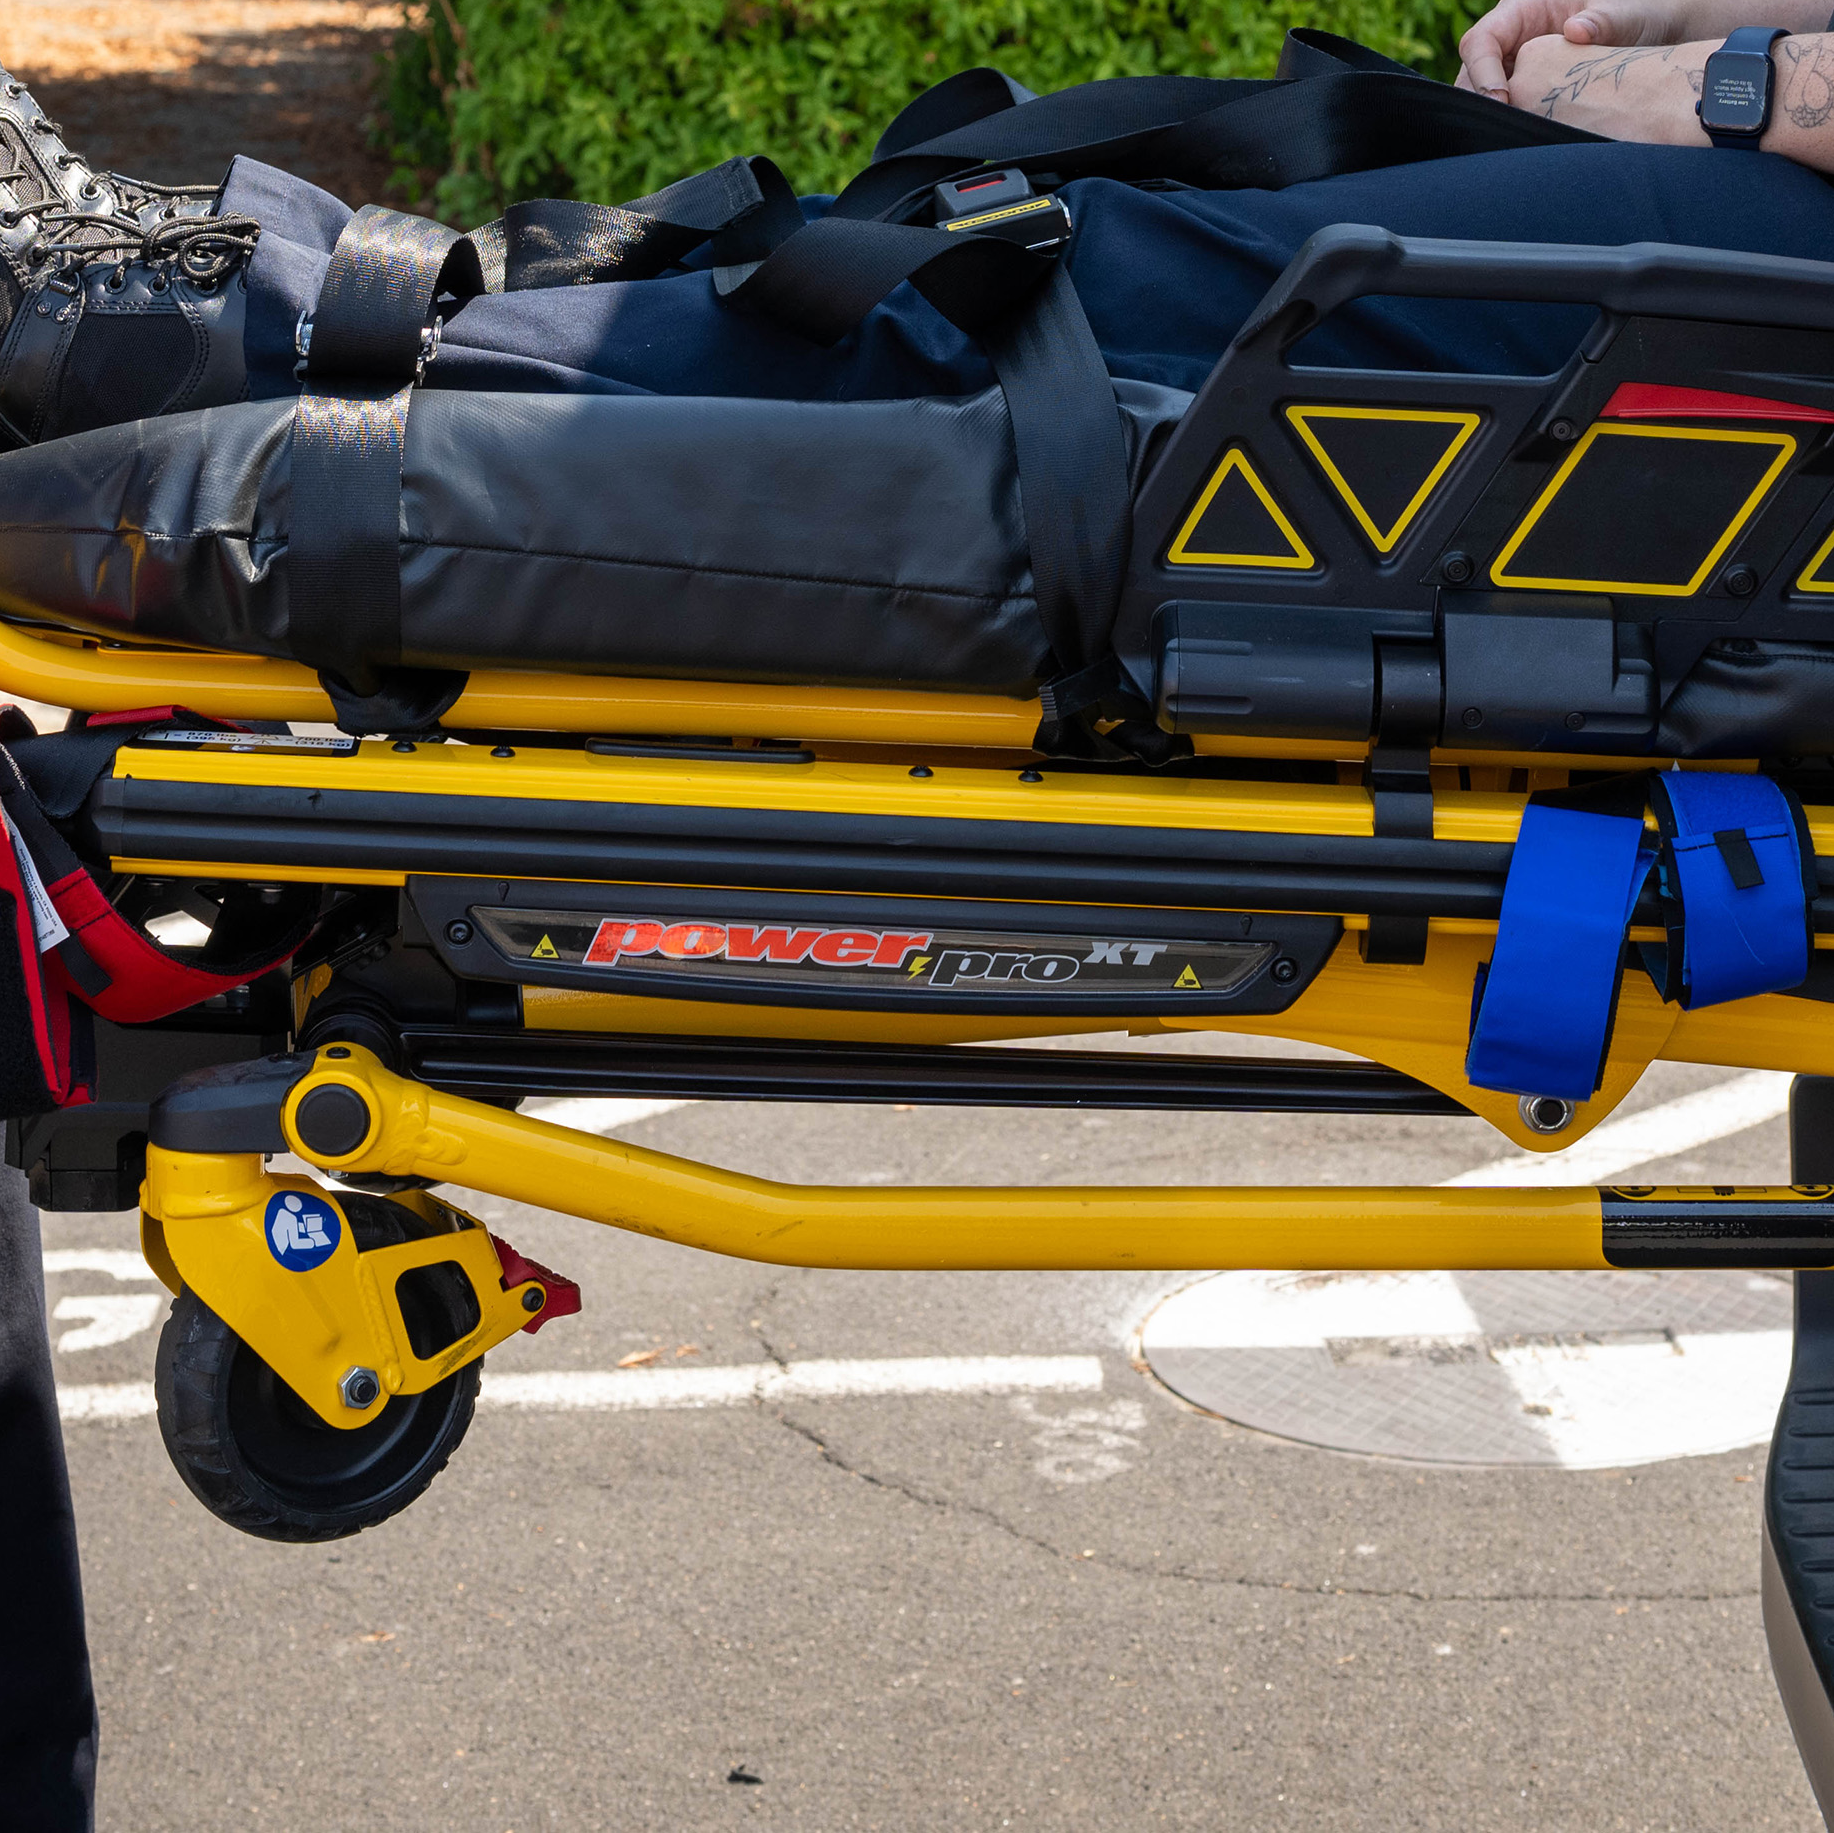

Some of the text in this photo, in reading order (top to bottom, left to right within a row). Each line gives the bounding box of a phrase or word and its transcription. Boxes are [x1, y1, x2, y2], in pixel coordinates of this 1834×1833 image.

[583, 918, 1168, 987] power pro XT
